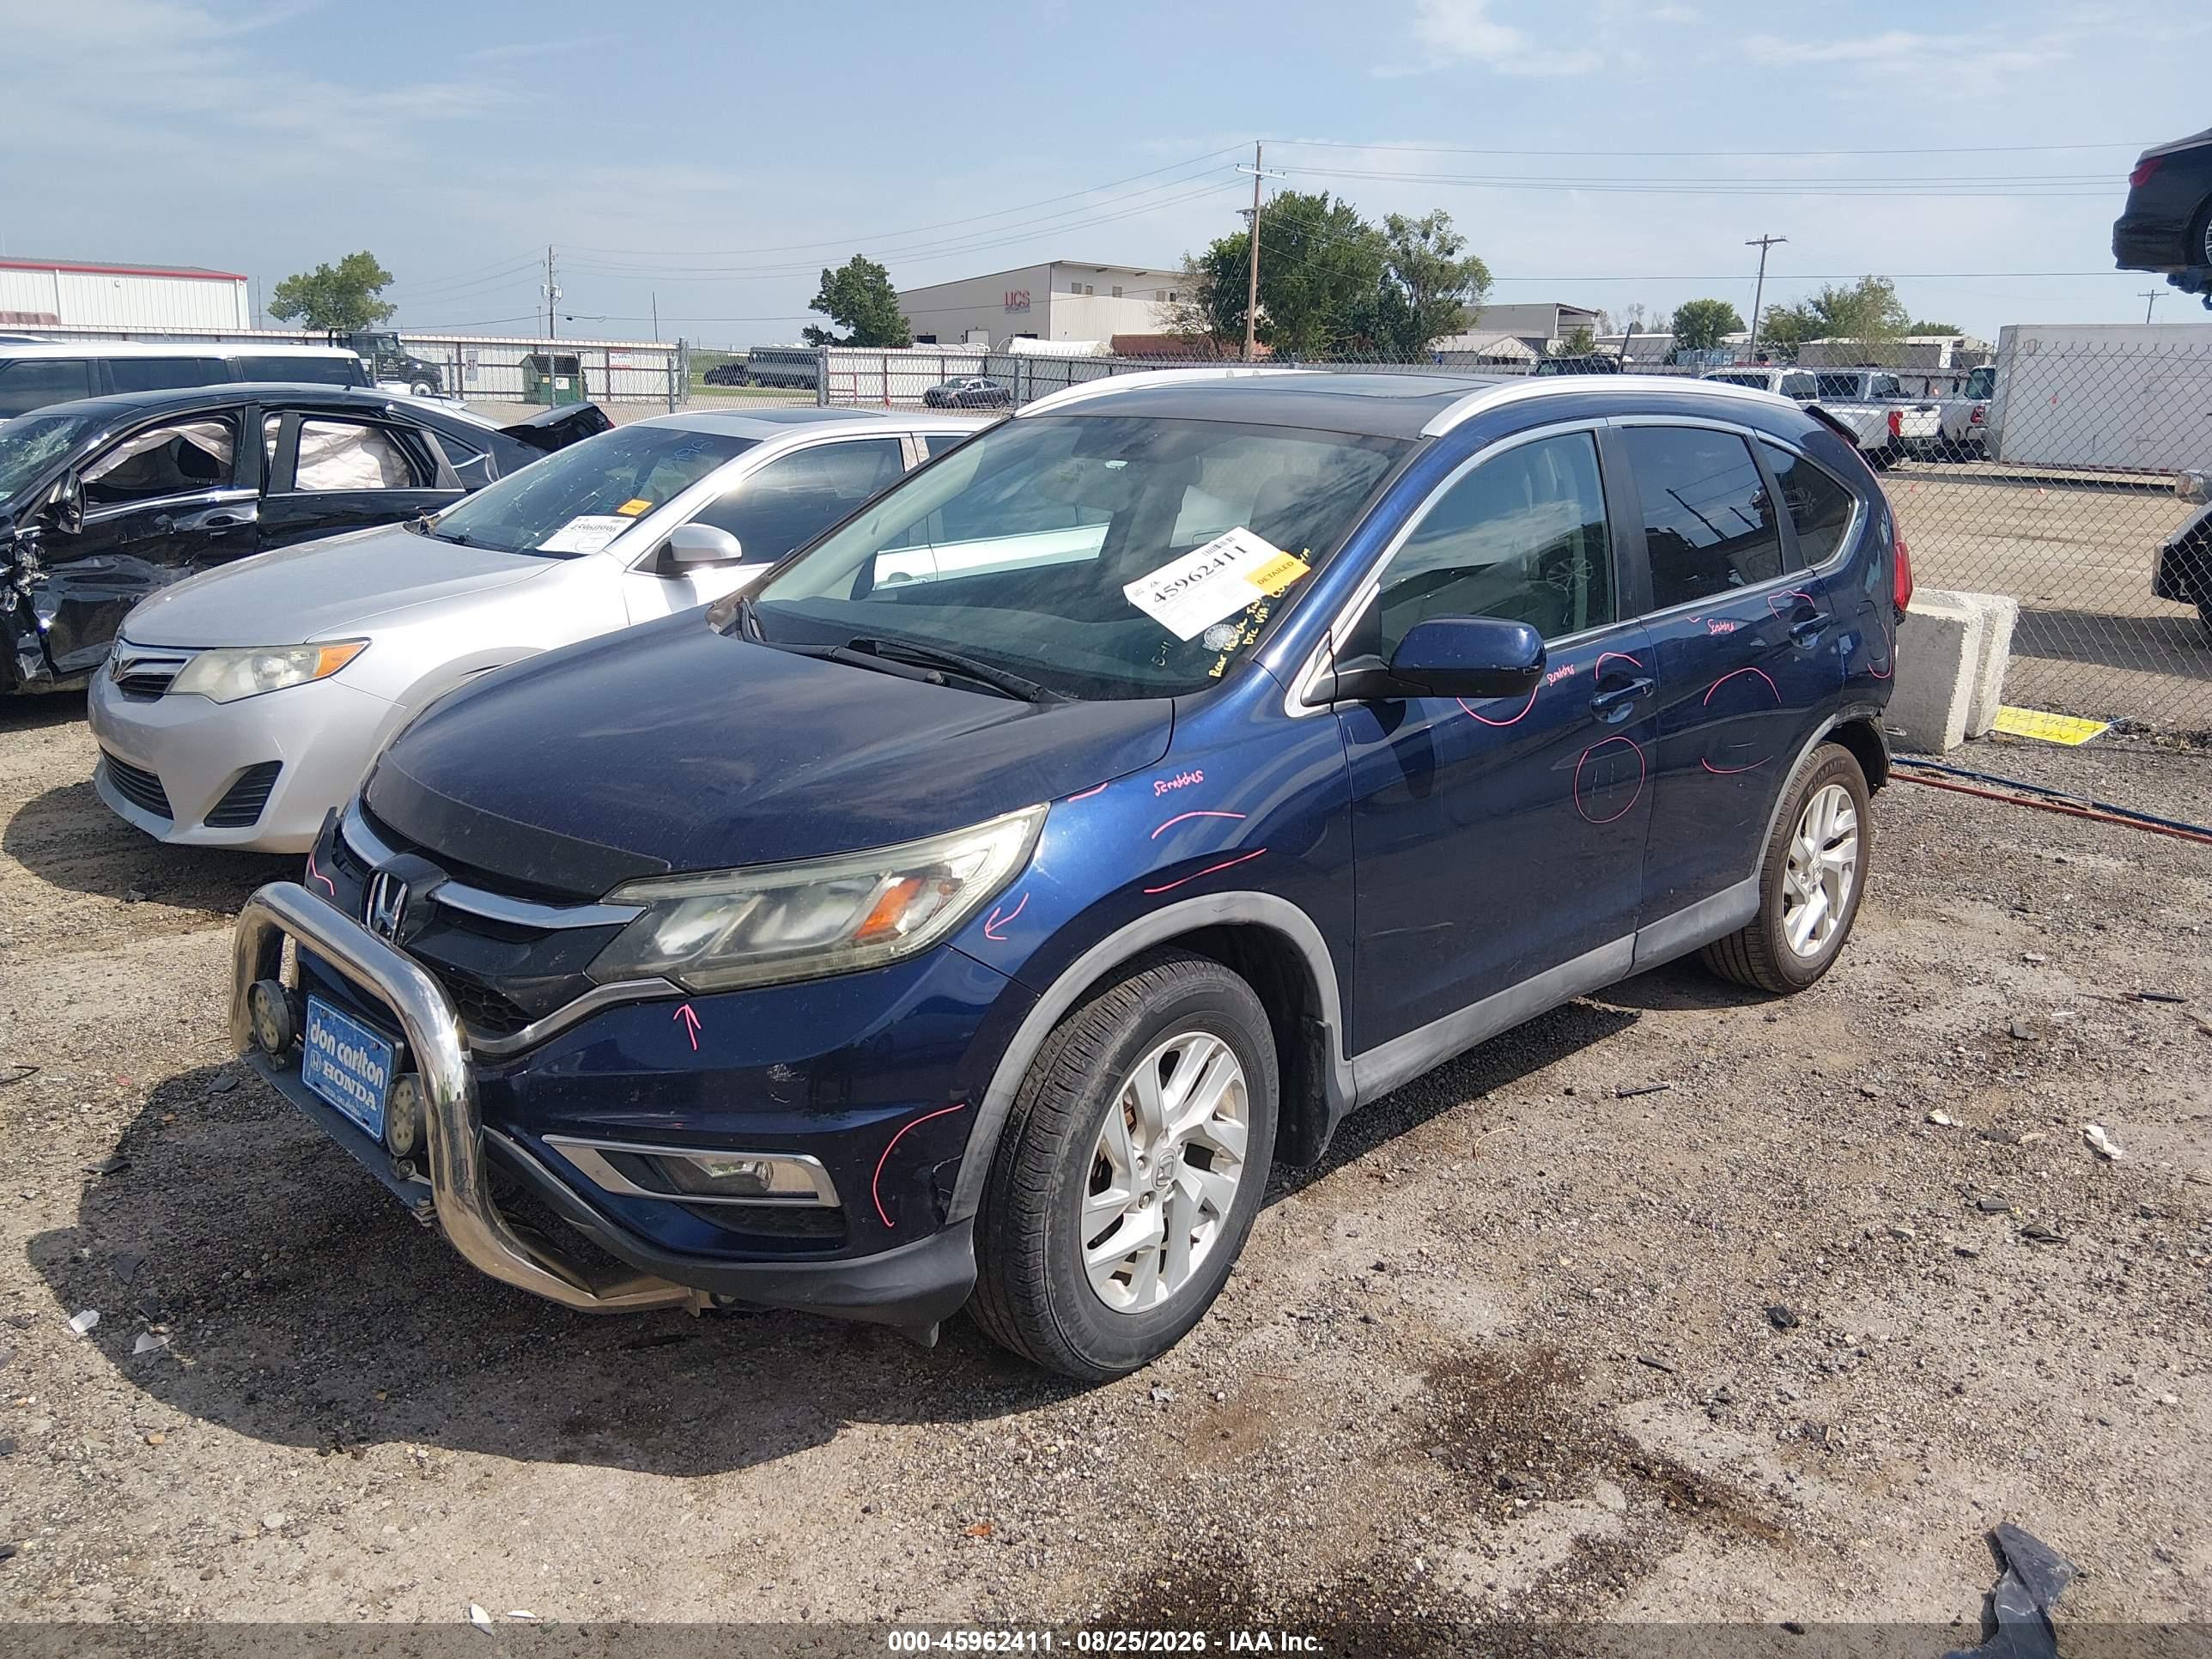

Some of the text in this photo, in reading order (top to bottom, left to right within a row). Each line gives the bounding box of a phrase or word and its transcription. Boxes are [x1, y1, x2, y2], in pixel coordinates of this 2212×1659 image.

[1004, 290, 1030, 307] UCS
[1153, 544, 1249, 604] 45962411
[1256, 561, 1295, 586] DETAILED
[322, 1060, 377, 1111] HONDA
[337, 1041, 385, 1090] carlton
